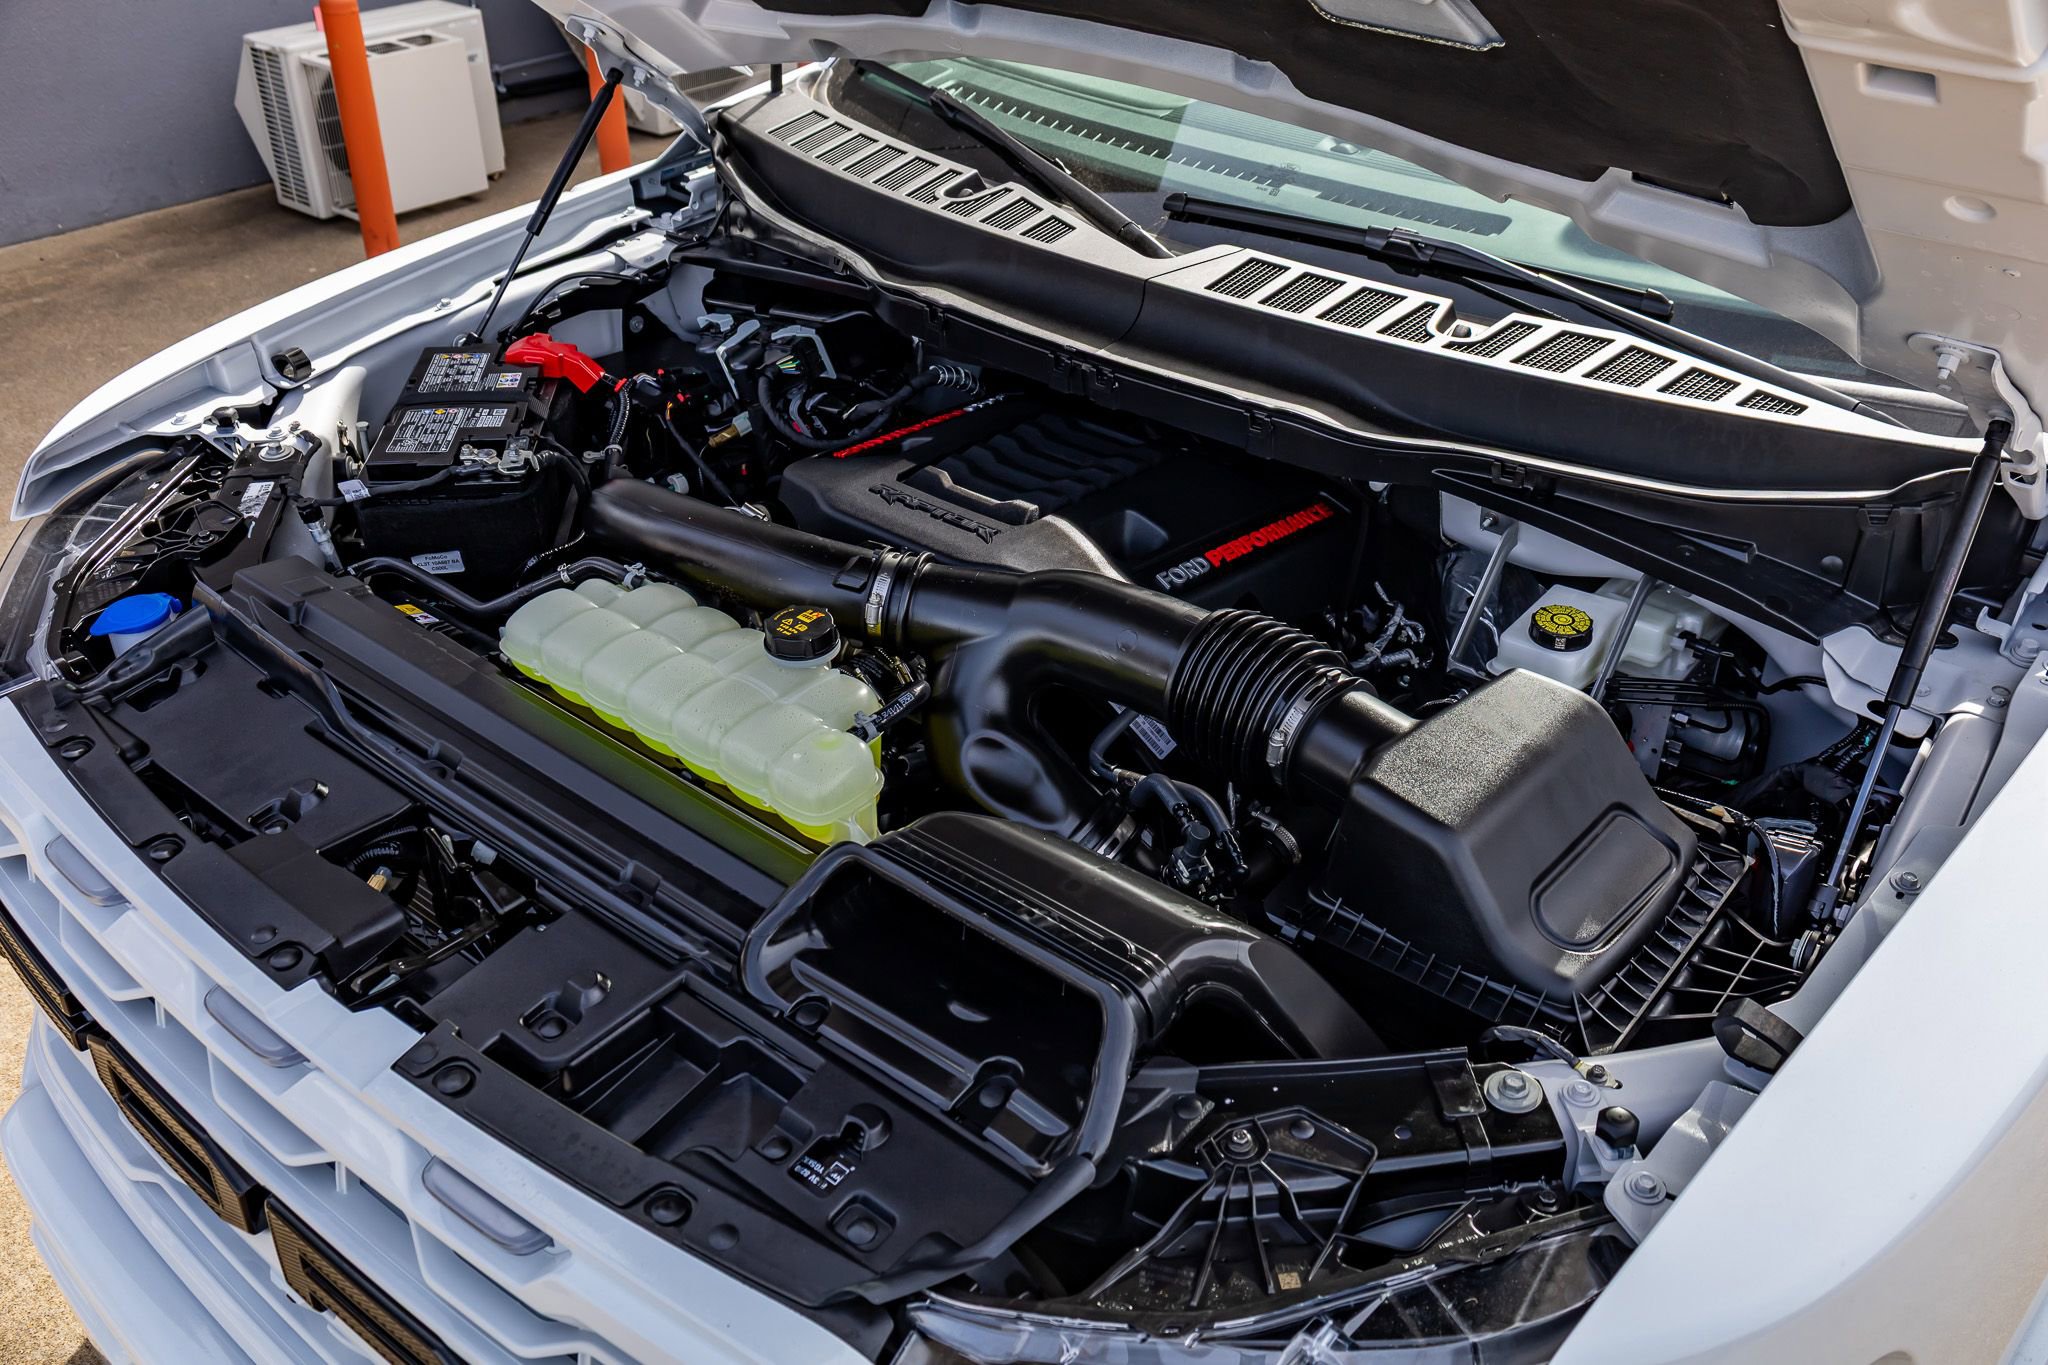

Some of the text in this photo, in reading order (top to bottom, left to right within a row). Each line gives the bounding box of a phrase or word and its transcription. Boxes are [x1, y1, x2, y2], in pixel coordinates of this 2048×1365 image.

[868, 484, 1001, 544] RAPTOR
[1155, 503, 1334, 590] FORD PERFORMANCE
